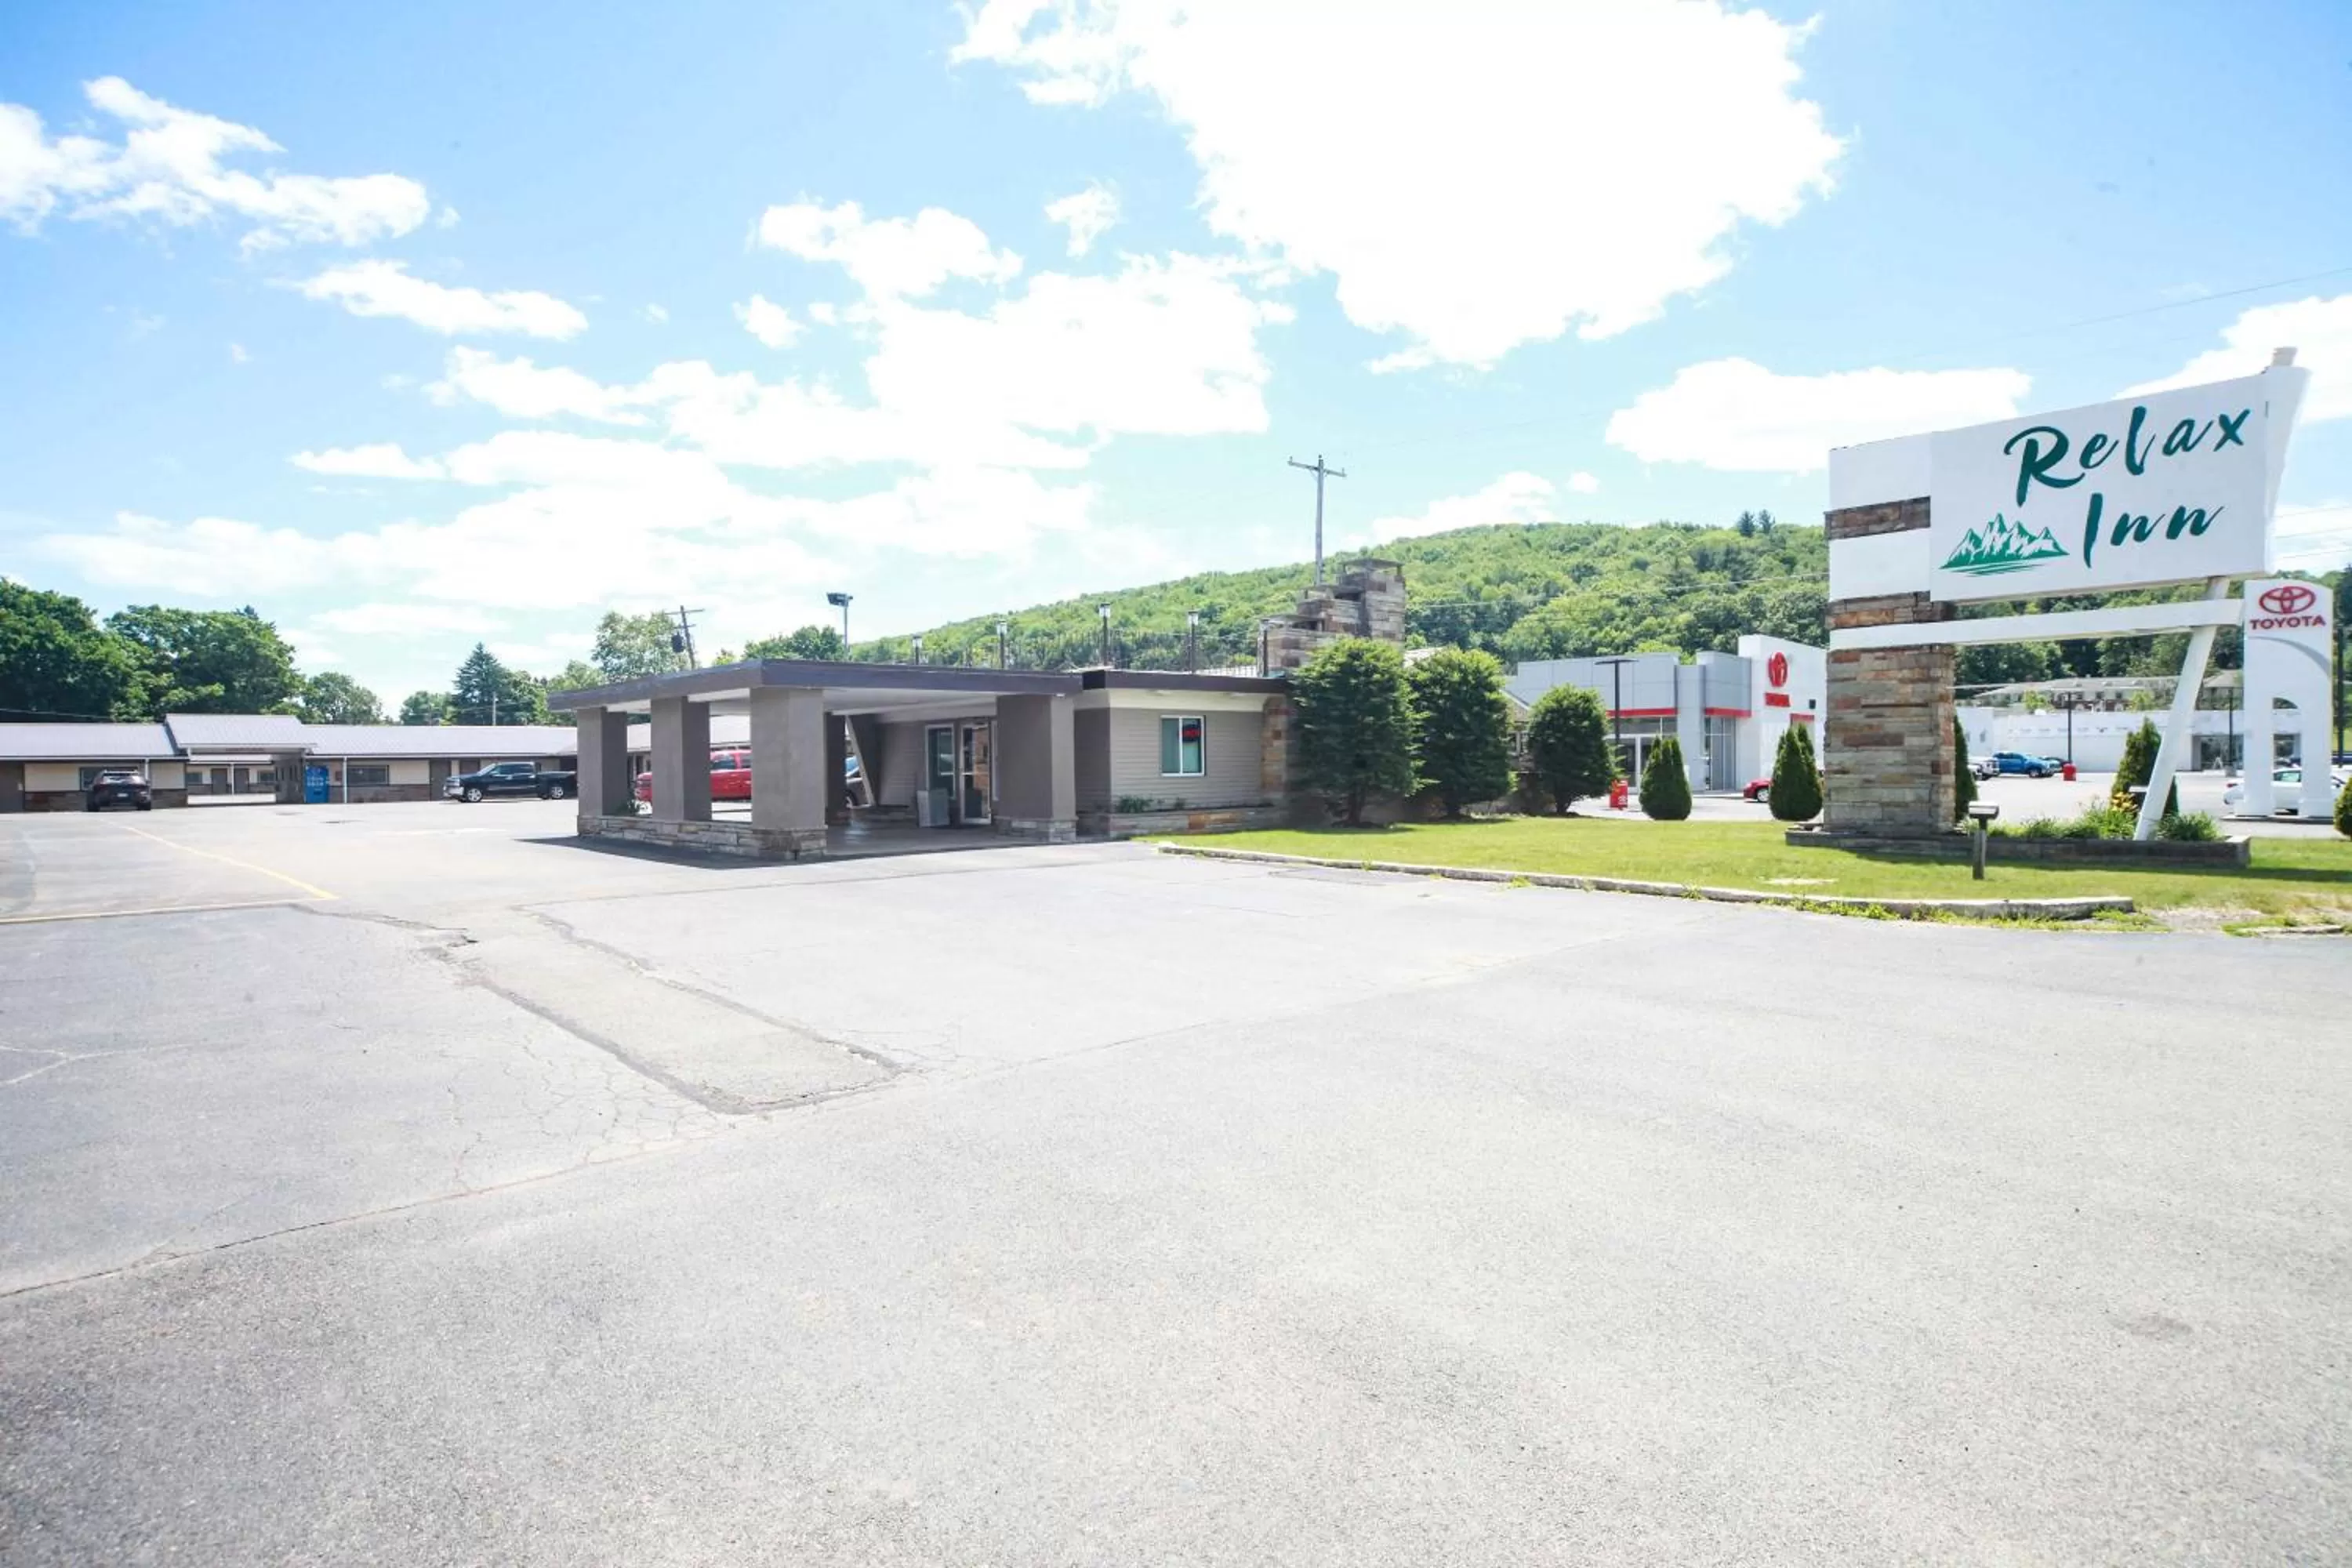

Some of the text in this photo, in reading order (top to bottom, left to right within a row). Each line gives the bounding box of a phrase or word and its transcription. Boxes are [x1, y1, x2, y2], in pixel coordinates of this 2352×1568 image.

[2004, 405, 2251, 507] Relax
[2083, 492, 2225, 568] Inn
[2249, 615, 2326, 630] TOYOTA
